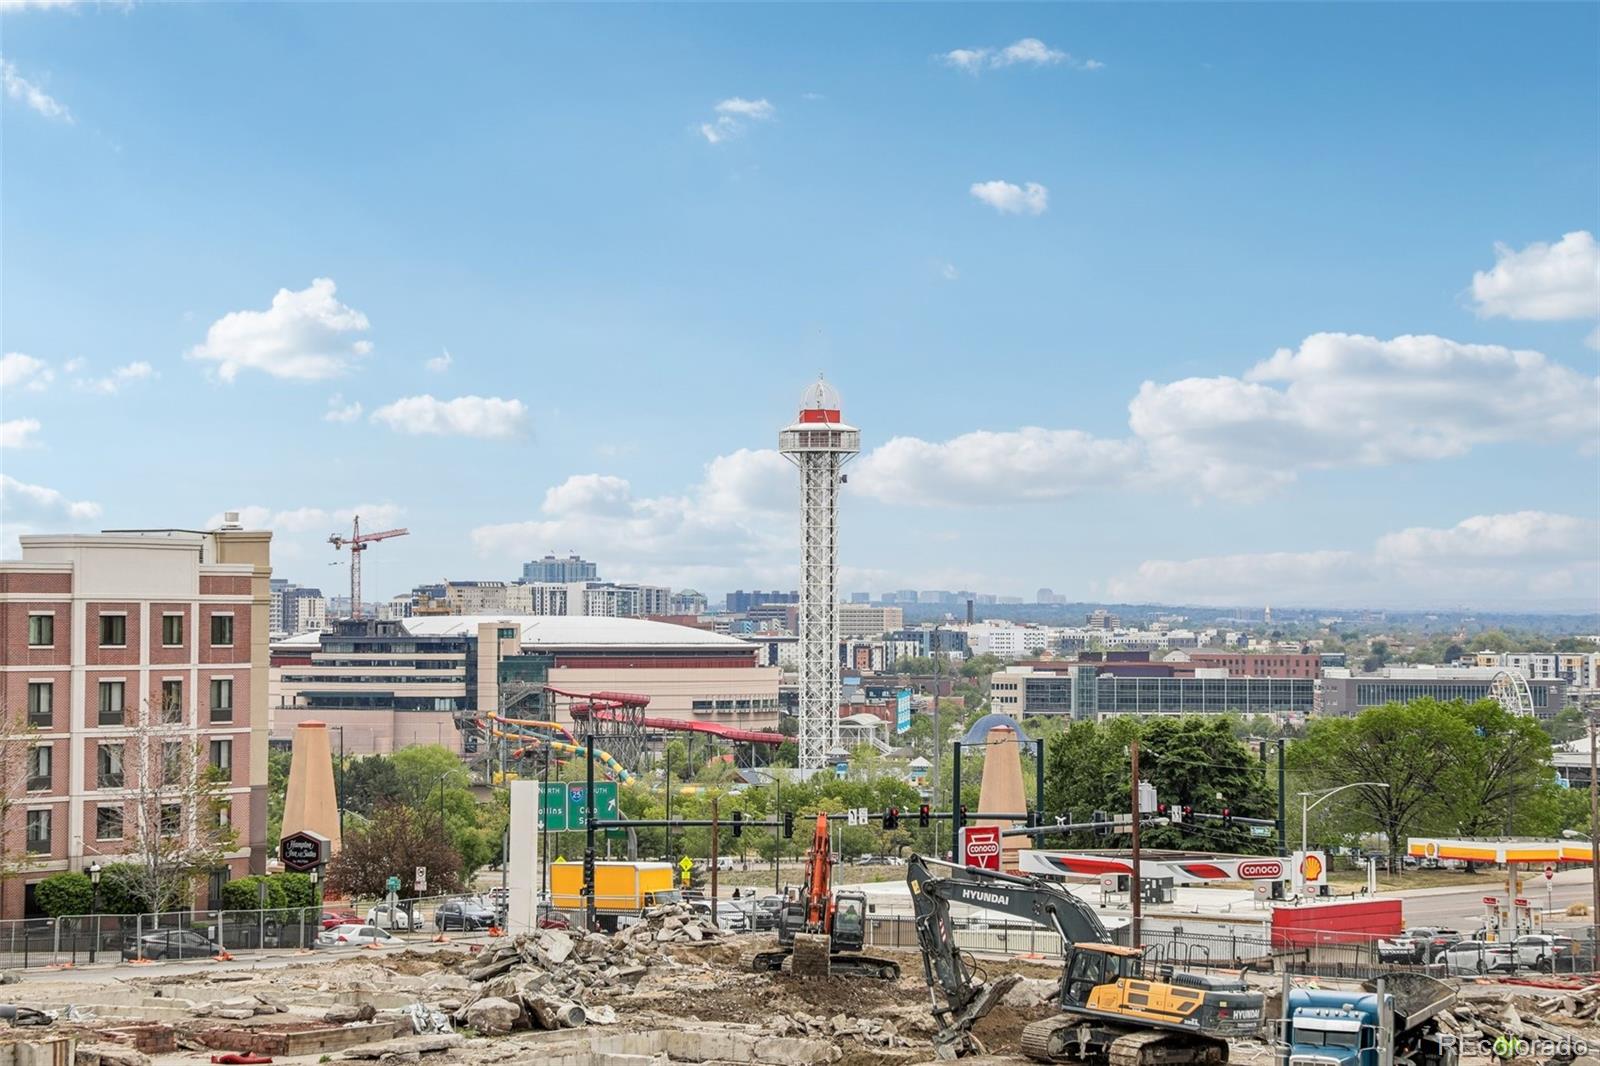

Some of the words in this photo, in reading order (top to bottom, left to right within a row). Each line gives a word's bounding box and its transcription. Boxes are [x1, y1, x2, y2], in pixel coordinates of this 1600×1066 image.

[538, 807, 562, 815] ollins
[962, 889, 1009, 905] HYUNDAI
[1233, 1009, 1260, 1020] HYUNDAI
